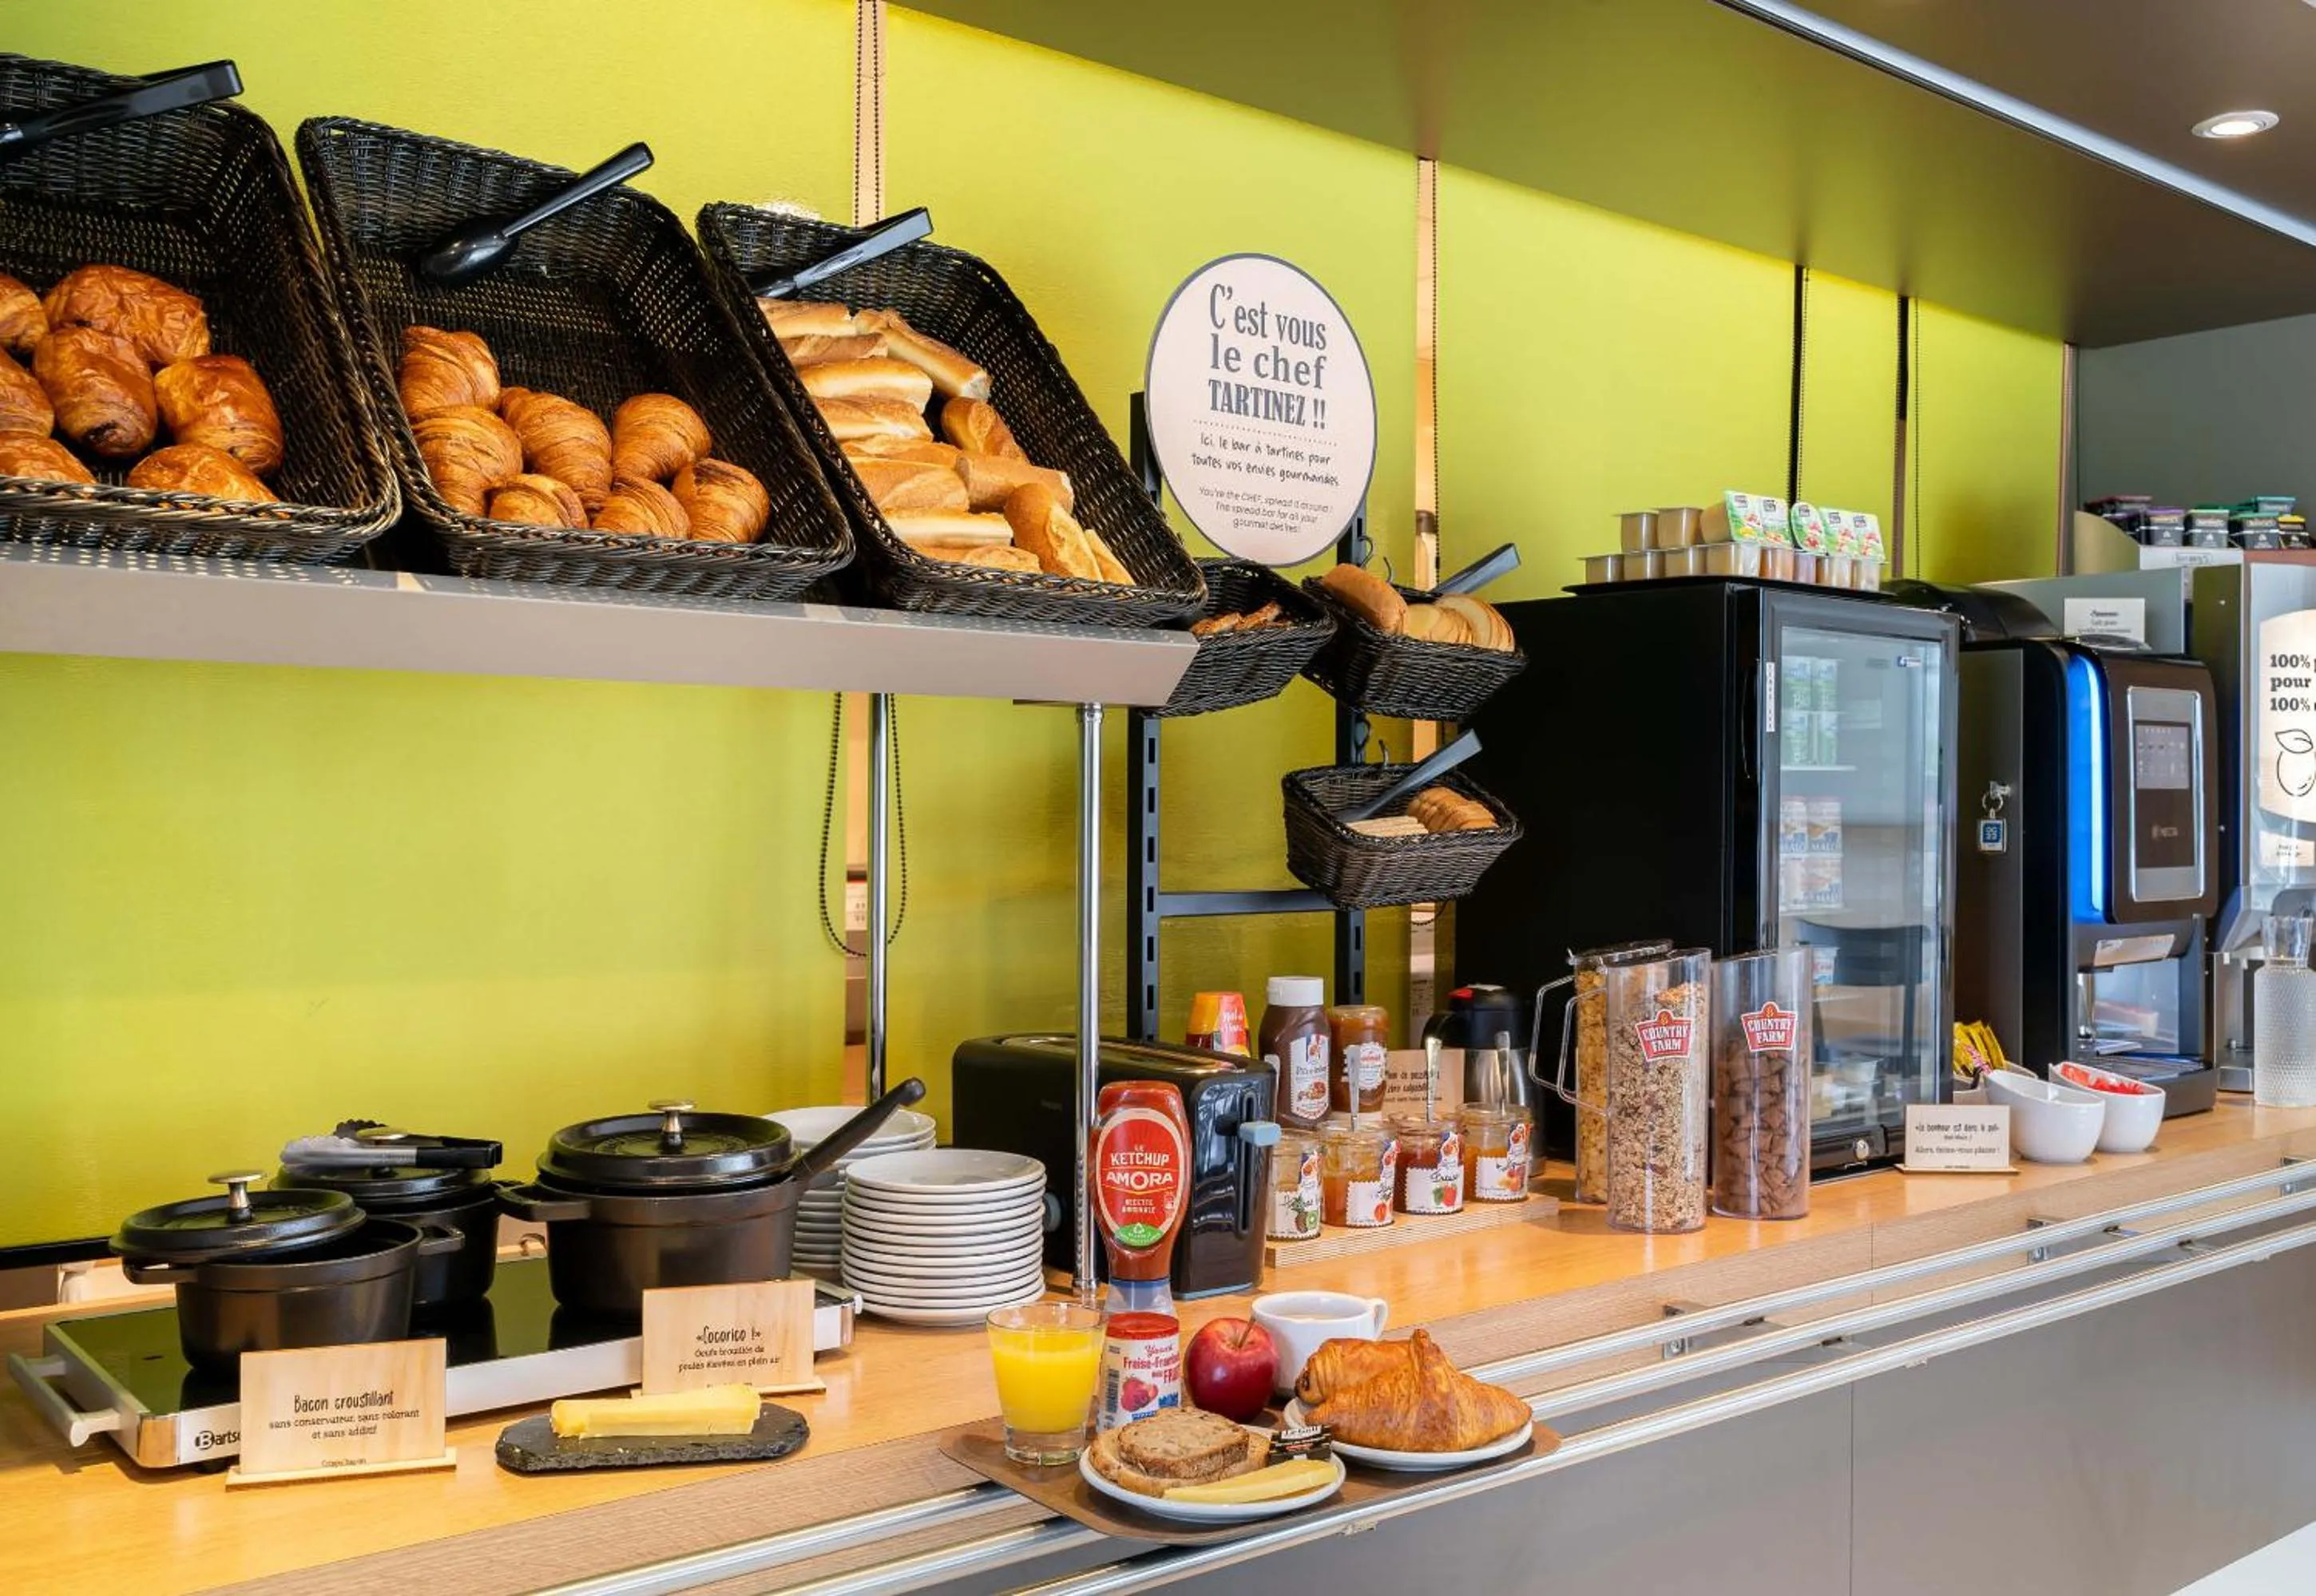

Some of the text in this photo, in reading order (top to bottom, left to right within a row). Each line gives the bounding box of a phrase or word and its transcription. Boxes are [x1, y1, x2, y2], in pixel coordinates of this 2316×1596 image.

[1210, 283, 1327, 350] C'est vous
[1210, 333, 1327, 389] le chef
[1208, 378, 1326, 430] TARTINEZ !!
[1219, 435, 1228, 449] le
[1231, 438, 1251, 453] bar
[1255, 441, 1262, 454] à
[1265, 445, 1304, 462] tartines
[1309, 454, 1331, 467] pour
[1226, 460, 1243, 472] vos
[1246, 463, 1276, 477] envies
[2270, 654, 2310, 668] 100%
[2270, 677, 2312, 692] pour
[2270, 697, 2310, 711] 100%
[1642, 1024, 1688, 1040] COUNTRY
[1747, 1018, 1791, 1032] COUNTRY
[1756, 1031, 1786, 1043] FARM
[1651, 1039, 1681, 1052] FARM
[1111, 1152, 1170, 1166] KETCHUP
[1106, 1171, 1173, 1190] AMORA
[748, 1356, 767, 1368] plein
[294, 1390, 394, 1413] Bacon croustillant
[268, 1420, 291, 1430] sans
[358, 1412, 380, 1423] sans
[382, 1408, 419, 1420] colorant
[311, 1431, 321, 1440] et
[323, 1429, 346, 1439] sans
